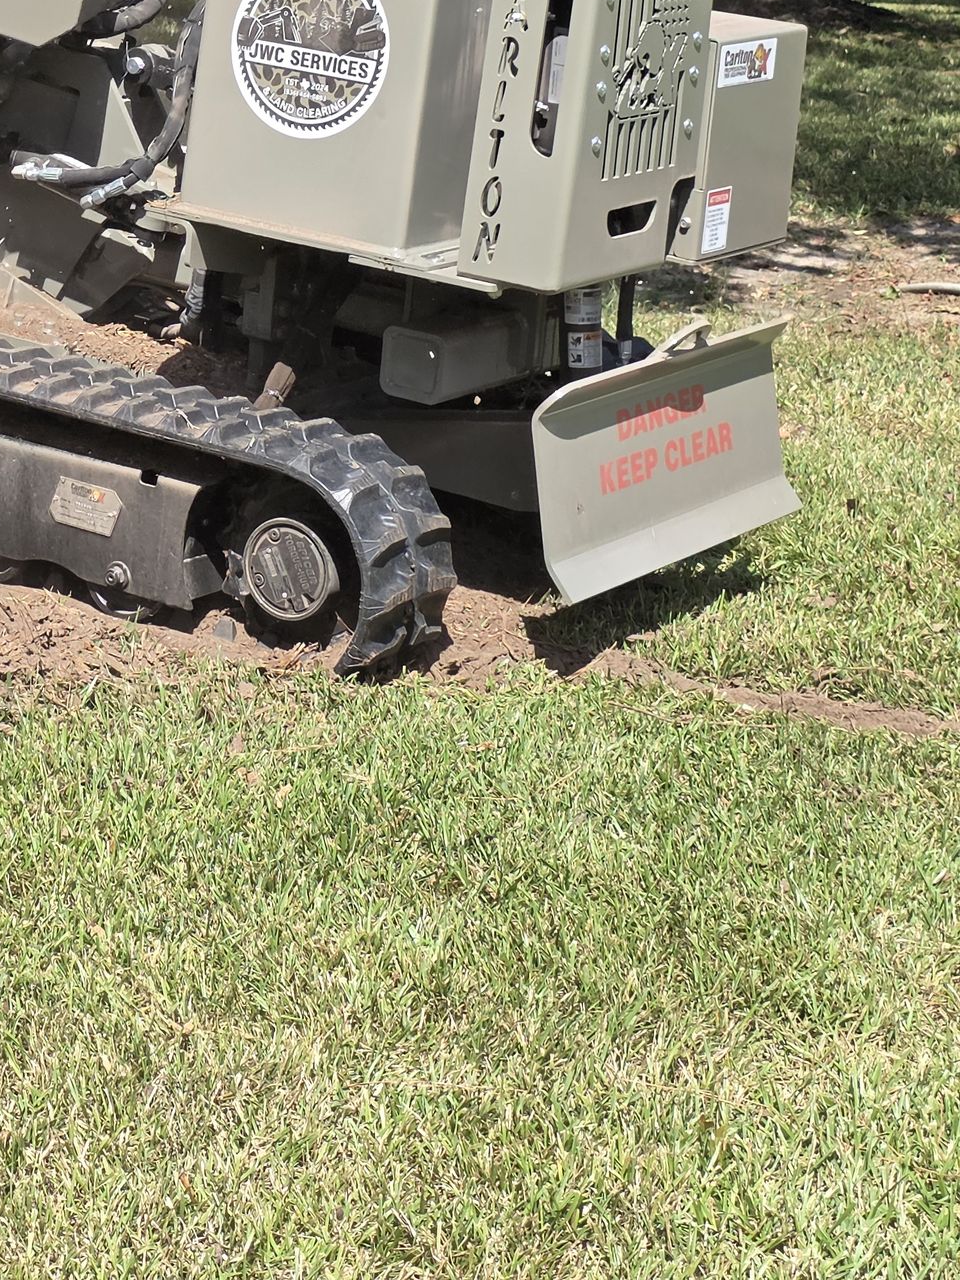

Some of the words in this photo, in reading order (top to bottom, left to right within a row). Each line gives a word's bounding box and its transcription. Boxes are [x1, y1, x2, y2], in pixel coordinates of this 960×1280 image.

[249, 43, 285, 63] JWC
[290, 49, 370, 79] SERVICES
[725, 49, 754, 67] Carlton
[268, 92, 295, 115] LAND
[296, 98, 347, 119] CLEARING
[616, 384, 708, 442] DANGER
[599, 446, 658, 496] KEEP
[663, 421, 734, 472] CLEAR
